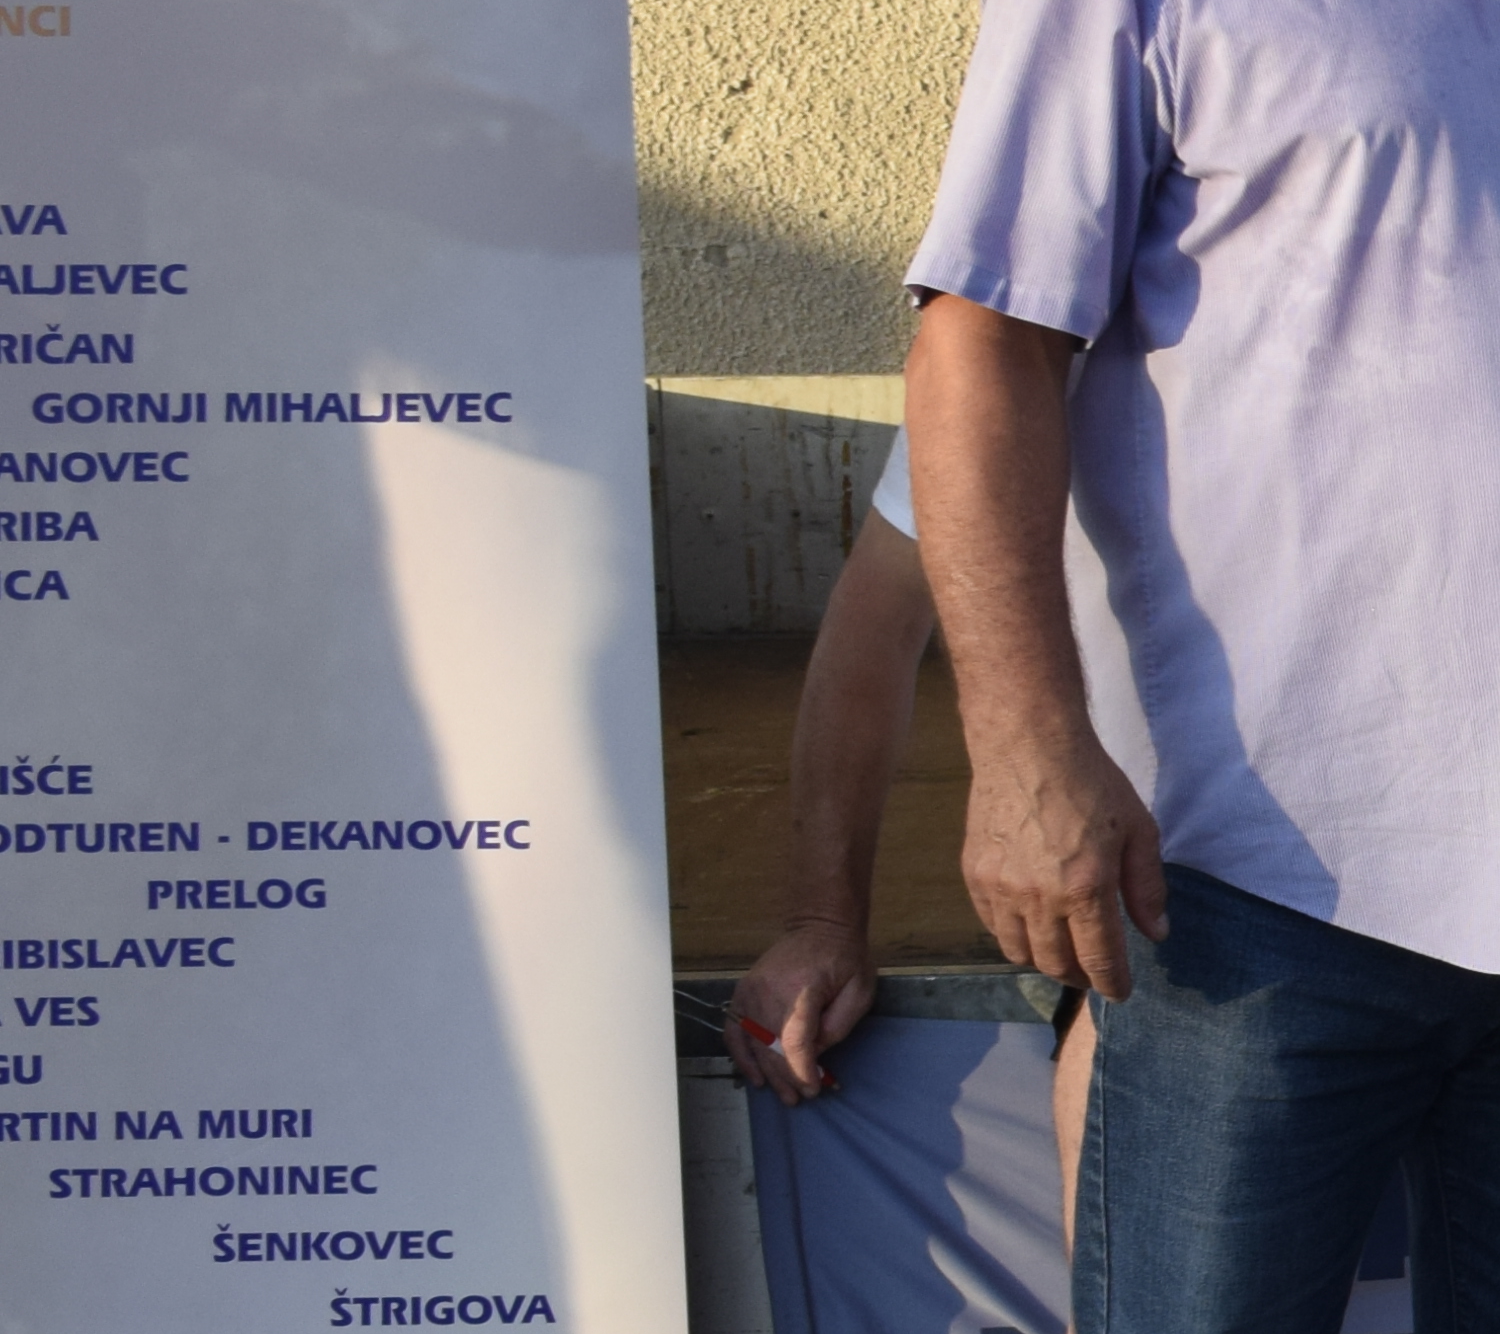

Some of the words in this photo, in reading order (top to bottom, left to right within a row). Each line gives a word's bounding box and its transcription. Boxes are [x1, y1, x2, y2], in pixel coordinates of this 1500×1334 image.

[0, 204, 68, 236] VA
[32, 392, 208, 424] GORNJI
[224, 392, 513, 423] MIHALJEVEC
[0, 451, 190, 483] ANOVEC
[246, 820, 531, 851] DEKANOVEC
[147, 879, 327, 910] PRELOG
[3, 937, 236, 970] IBISLAVEC
[13, 996, 100, 1026] VES
[115, 1110, 184, 1140] NA
[198, 1109, 313, 1139] MURI
[48, 1165, 378, 1199] STRAHONINEC
[212, 1224, 454, 1262] ŠENKOVEC
[330, 1288, 556, 1327] ŠTRIGOVA
